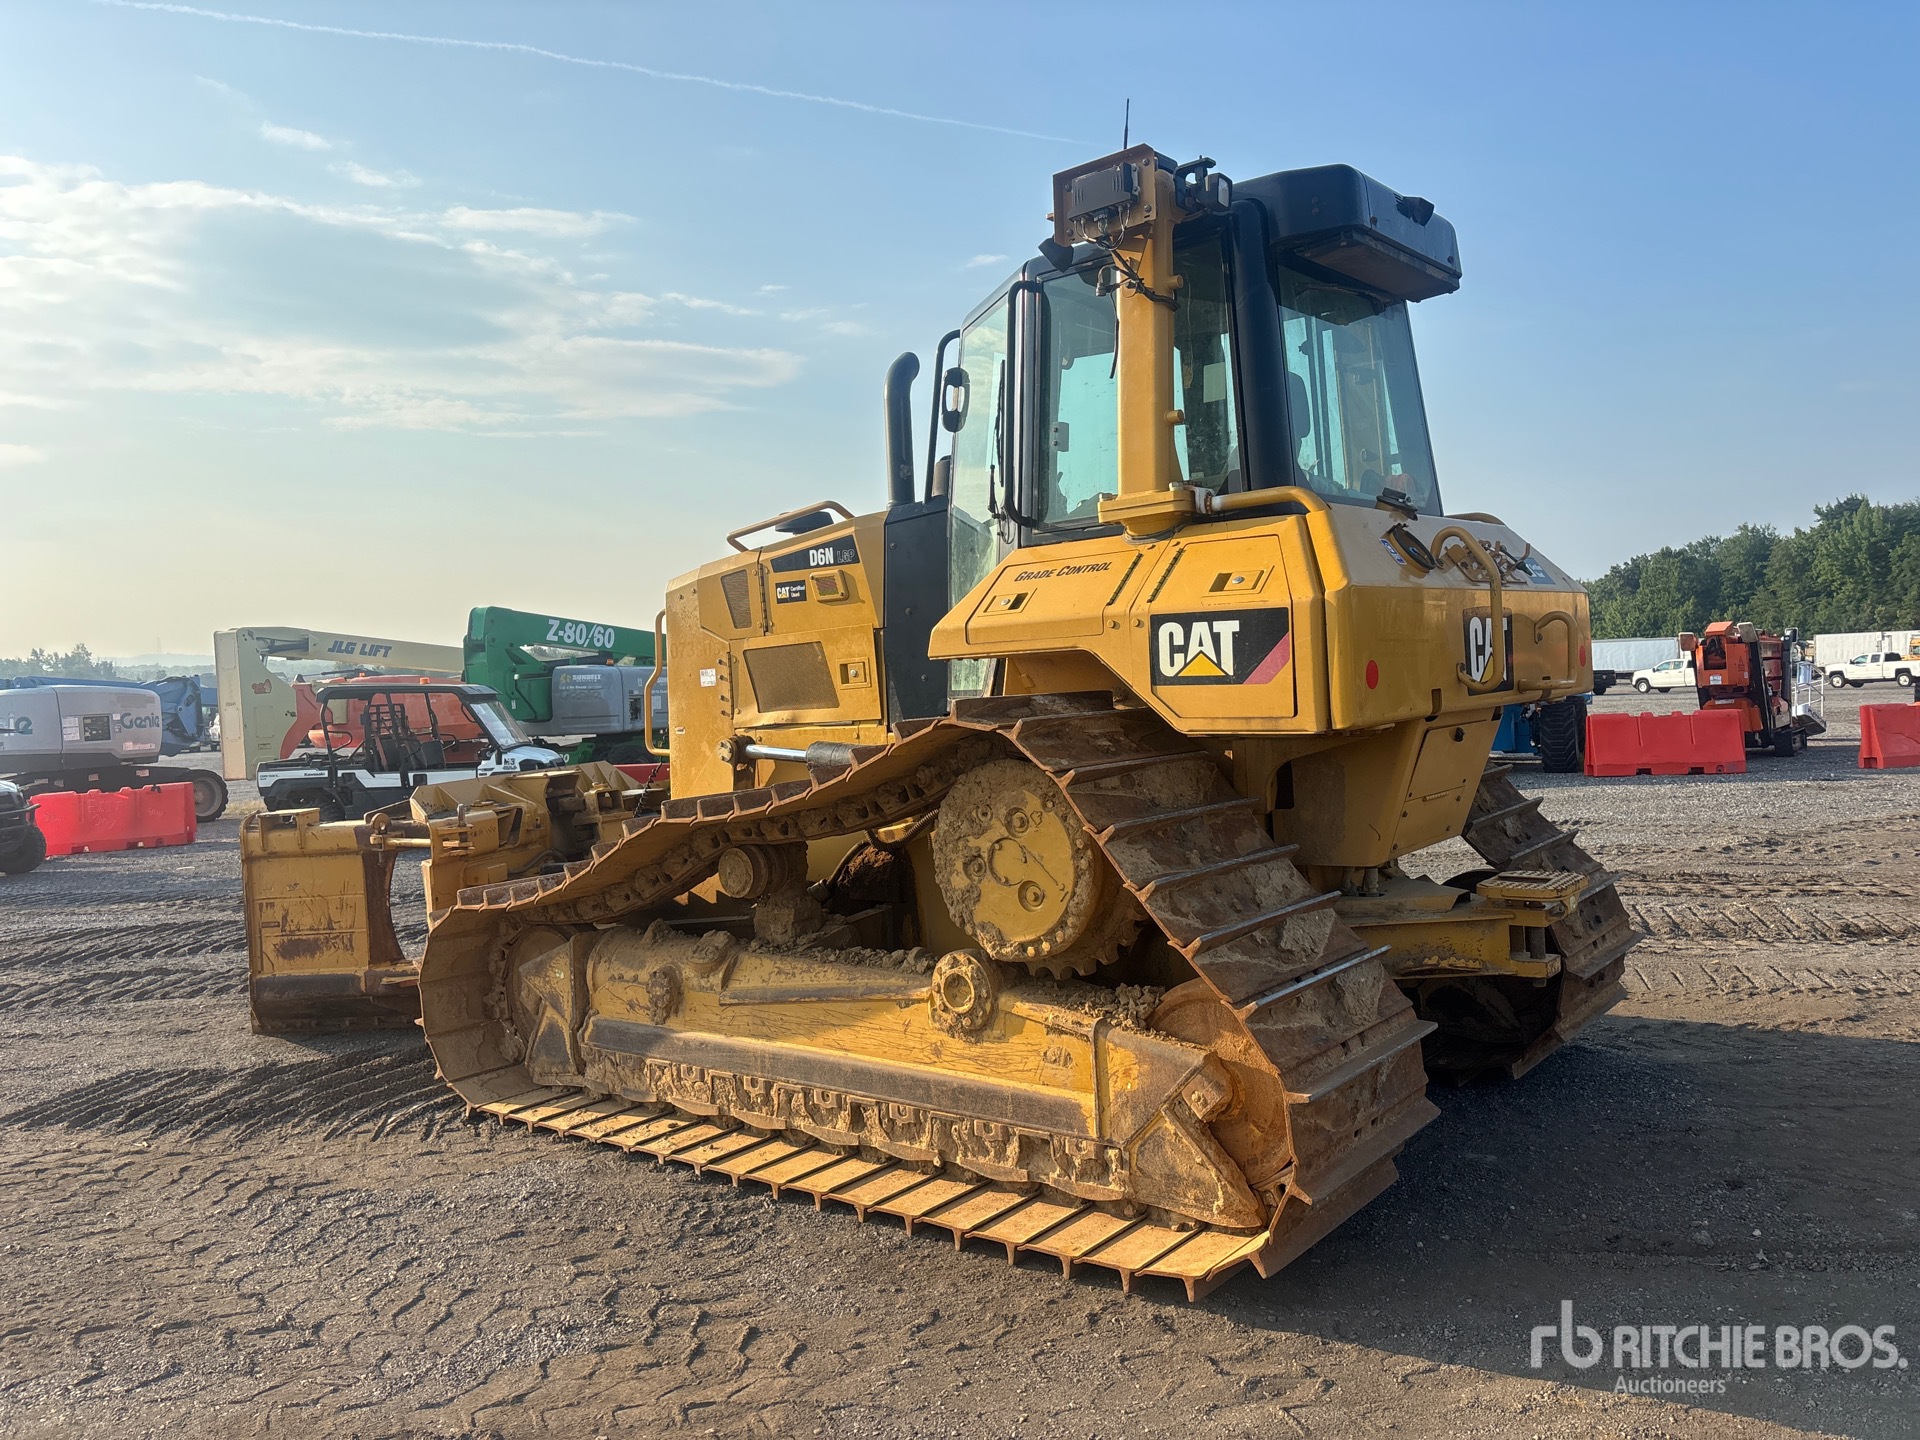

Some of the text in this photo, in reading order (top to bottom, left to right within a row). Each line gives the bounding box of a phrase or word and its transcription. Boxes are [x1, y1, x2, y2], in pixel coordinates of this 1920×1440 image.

[809, 547, 834, 566] D6N
[1014, 561, 1112, 582] GRADE CONTROL
[776, 587, 790, 599] CAT
[546, 619, 615, 648] Z-80/60
[327, 640, 393, 658] JLG LIFT
[1158, 620, 1240, 677] CAT
[120, 713, 160, 729] Genie
